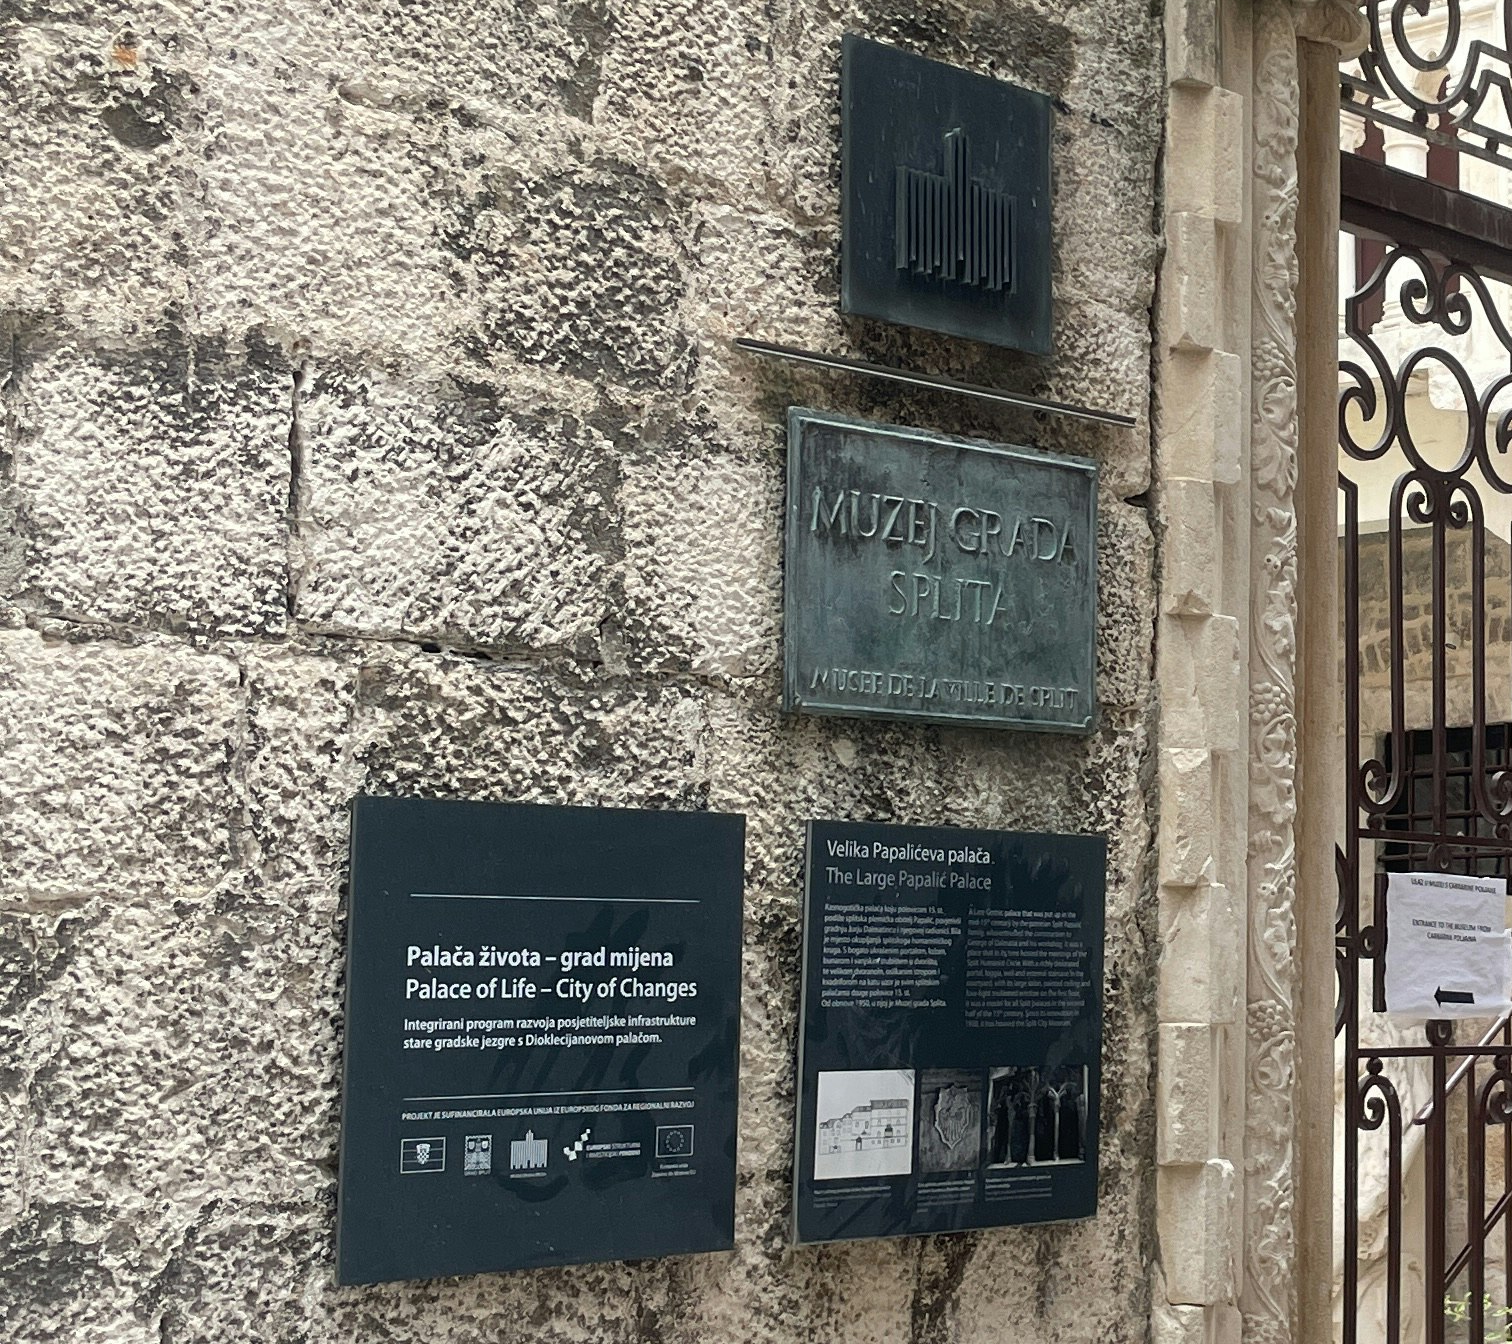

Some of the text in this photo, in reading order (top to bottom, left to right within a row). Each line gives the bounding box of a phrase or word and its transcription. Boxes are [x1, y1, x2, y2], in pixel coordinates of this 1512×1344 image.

[810, 485, 1077, 565] MUZEJ GRADA
[888, 570, 1011, 625] SPLITA
[888, 673, 913, 697] DE
[943, 678, 996, 703] VILLE
[1000, 682, 1024, 705] DE
[1030, 685, 1078, 709] SPLIT
[827, 840, 990, 866] Velika Papalićeva palača
[826, 867, 992, 890] The Large Papalić Palace
[406, 945, 475, 966] Palača
[478, 946, 541, 966] života
[560, 947, 605, 972] grad
[609, 946, 673, 972] mijena
[405, 978, 471, 999] Palace
[476, 978, 497, 999] of
[500, 978, 537, 999] Life
[556, 978, 592, 1003] City
[596, 977, 617, 997] of
[620, 978, 697, 1002] Changes
[404, 1014, 697, 1034] Integrirani program razvoja posjetiteljske infrastrukture
[403, 1032, 662, 1052] stare gradske jezgre s Dioklecijanovom palačom.
[402, 1111, 432, 1120] PROJEKT
